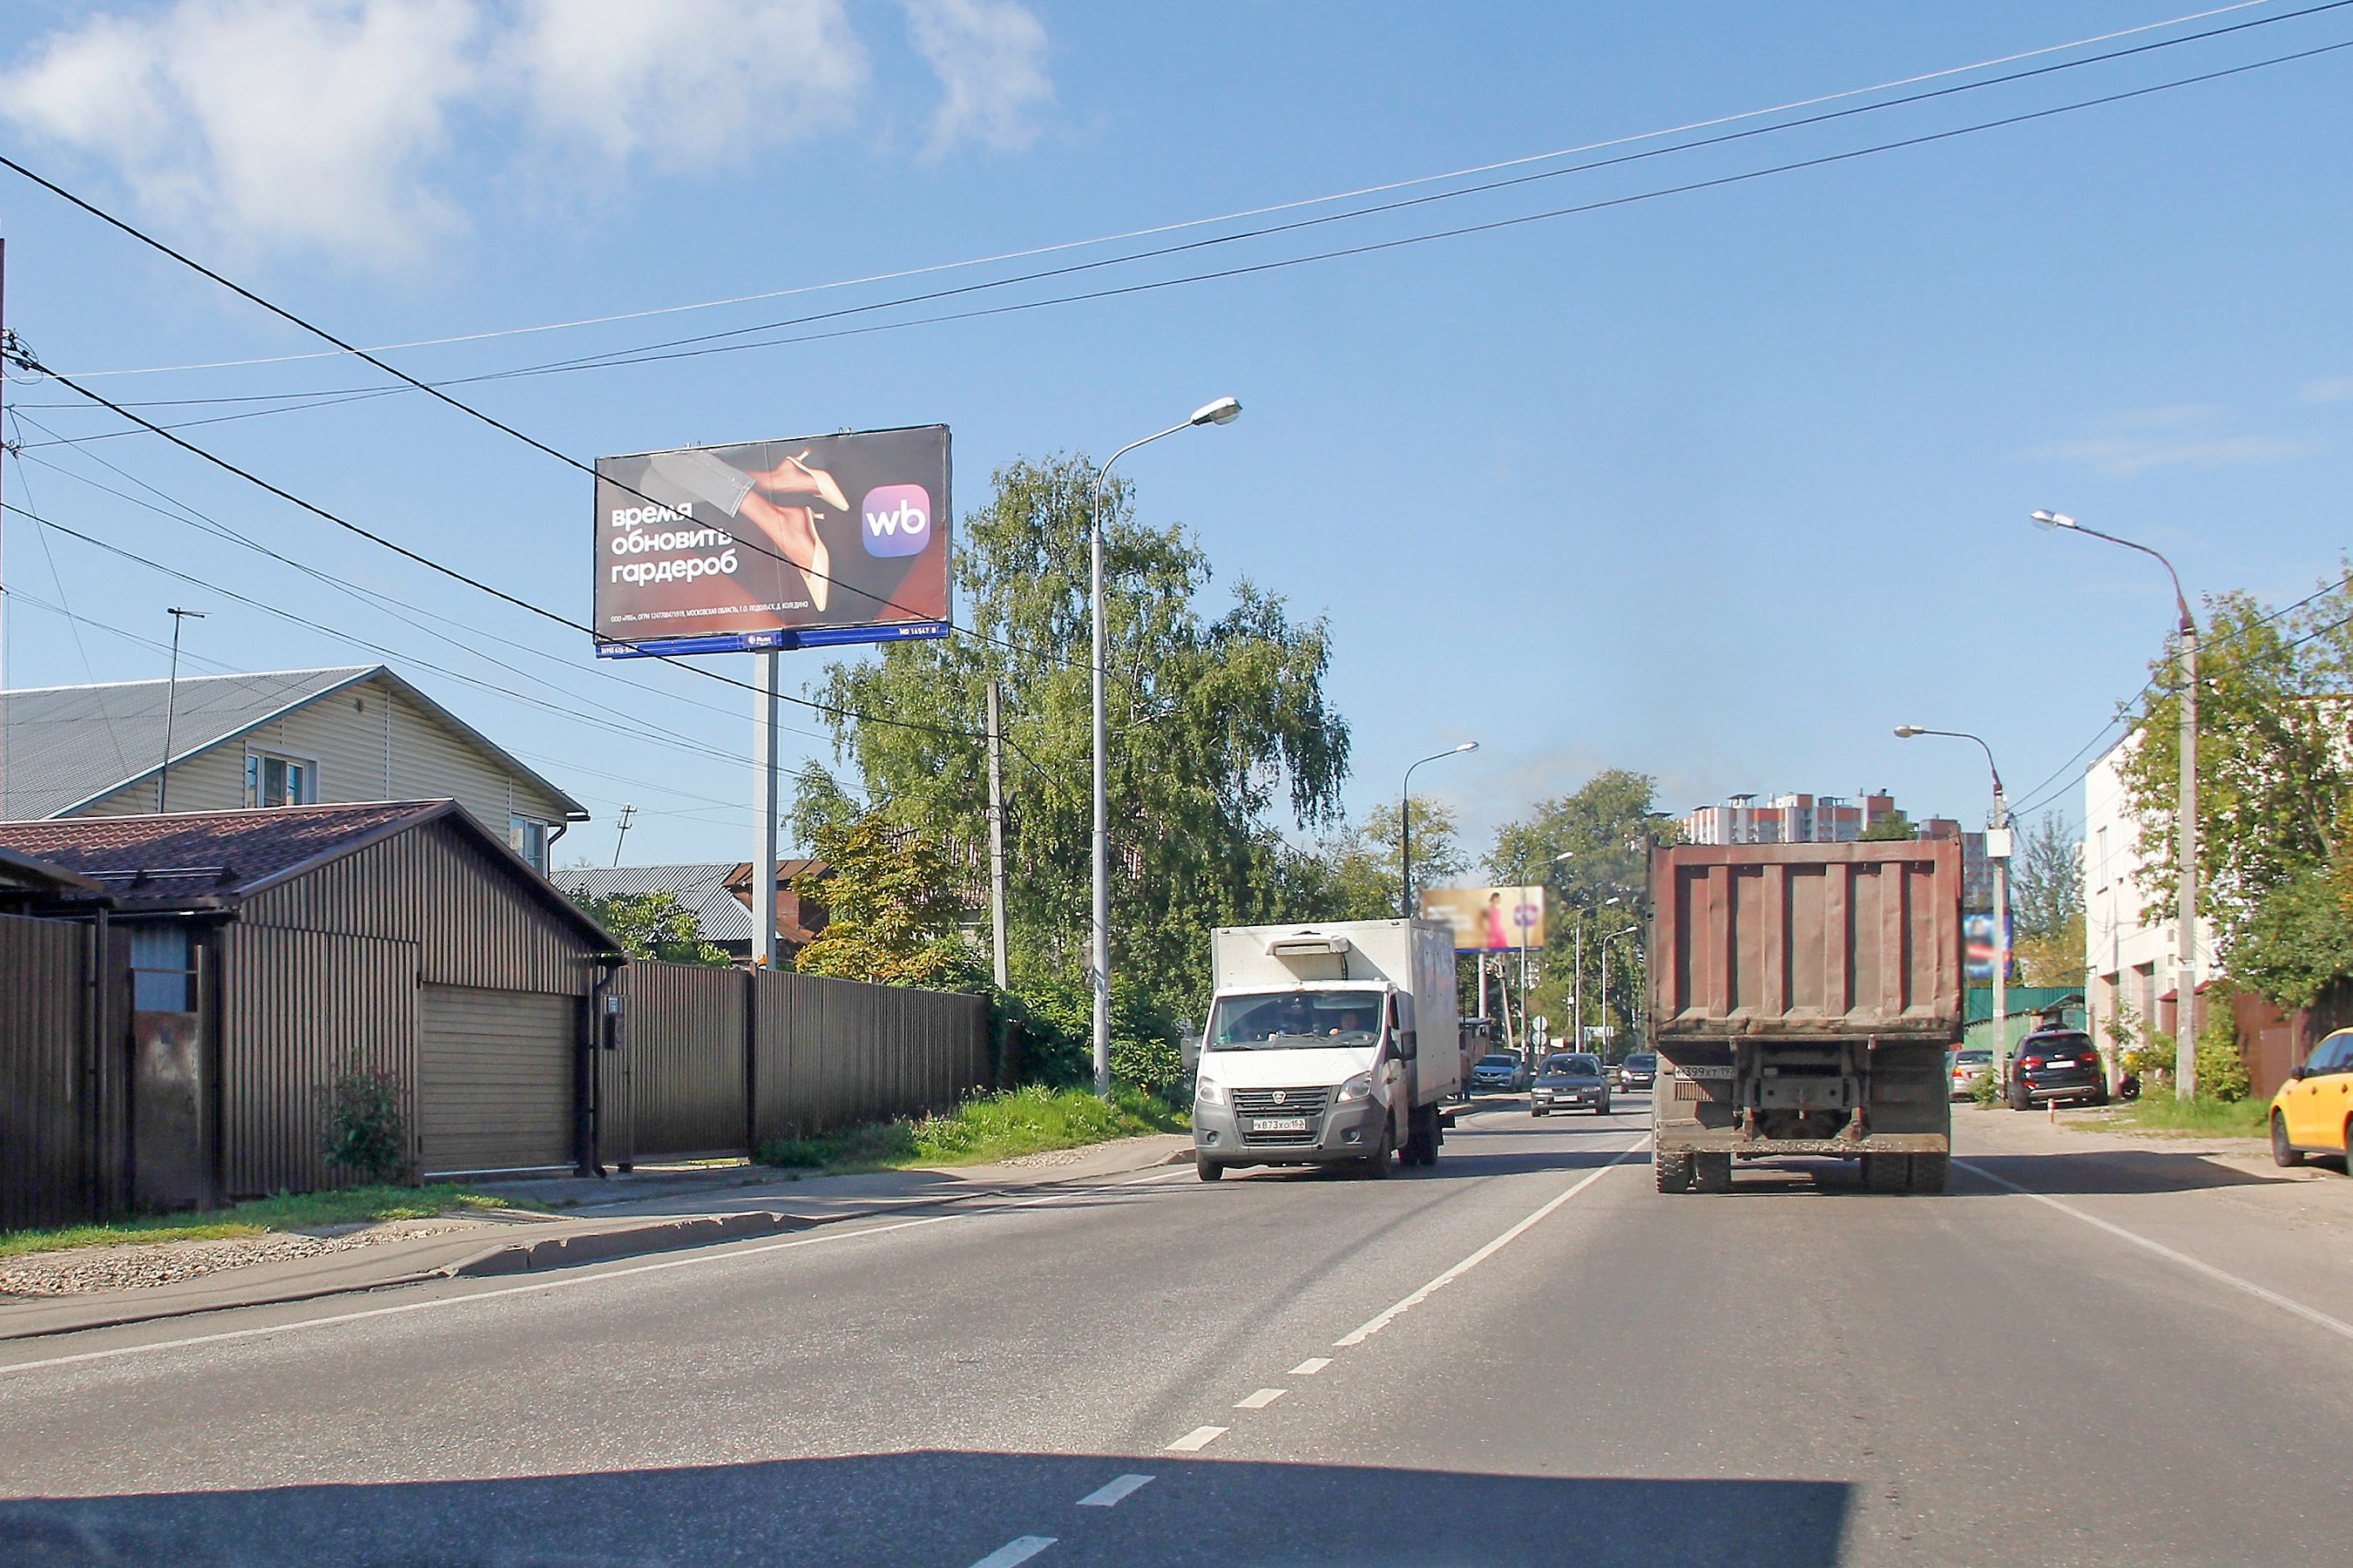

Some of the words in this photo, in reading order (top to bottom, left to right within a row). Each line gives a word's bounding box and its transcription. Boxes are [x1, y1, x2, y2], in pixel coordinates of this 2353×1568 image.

[612, 503, 693, 531] время
[866, 499, 926, 537] wb
[611, 528, 734, 555] обновить
[612, 548, 738, 586] гардероб
